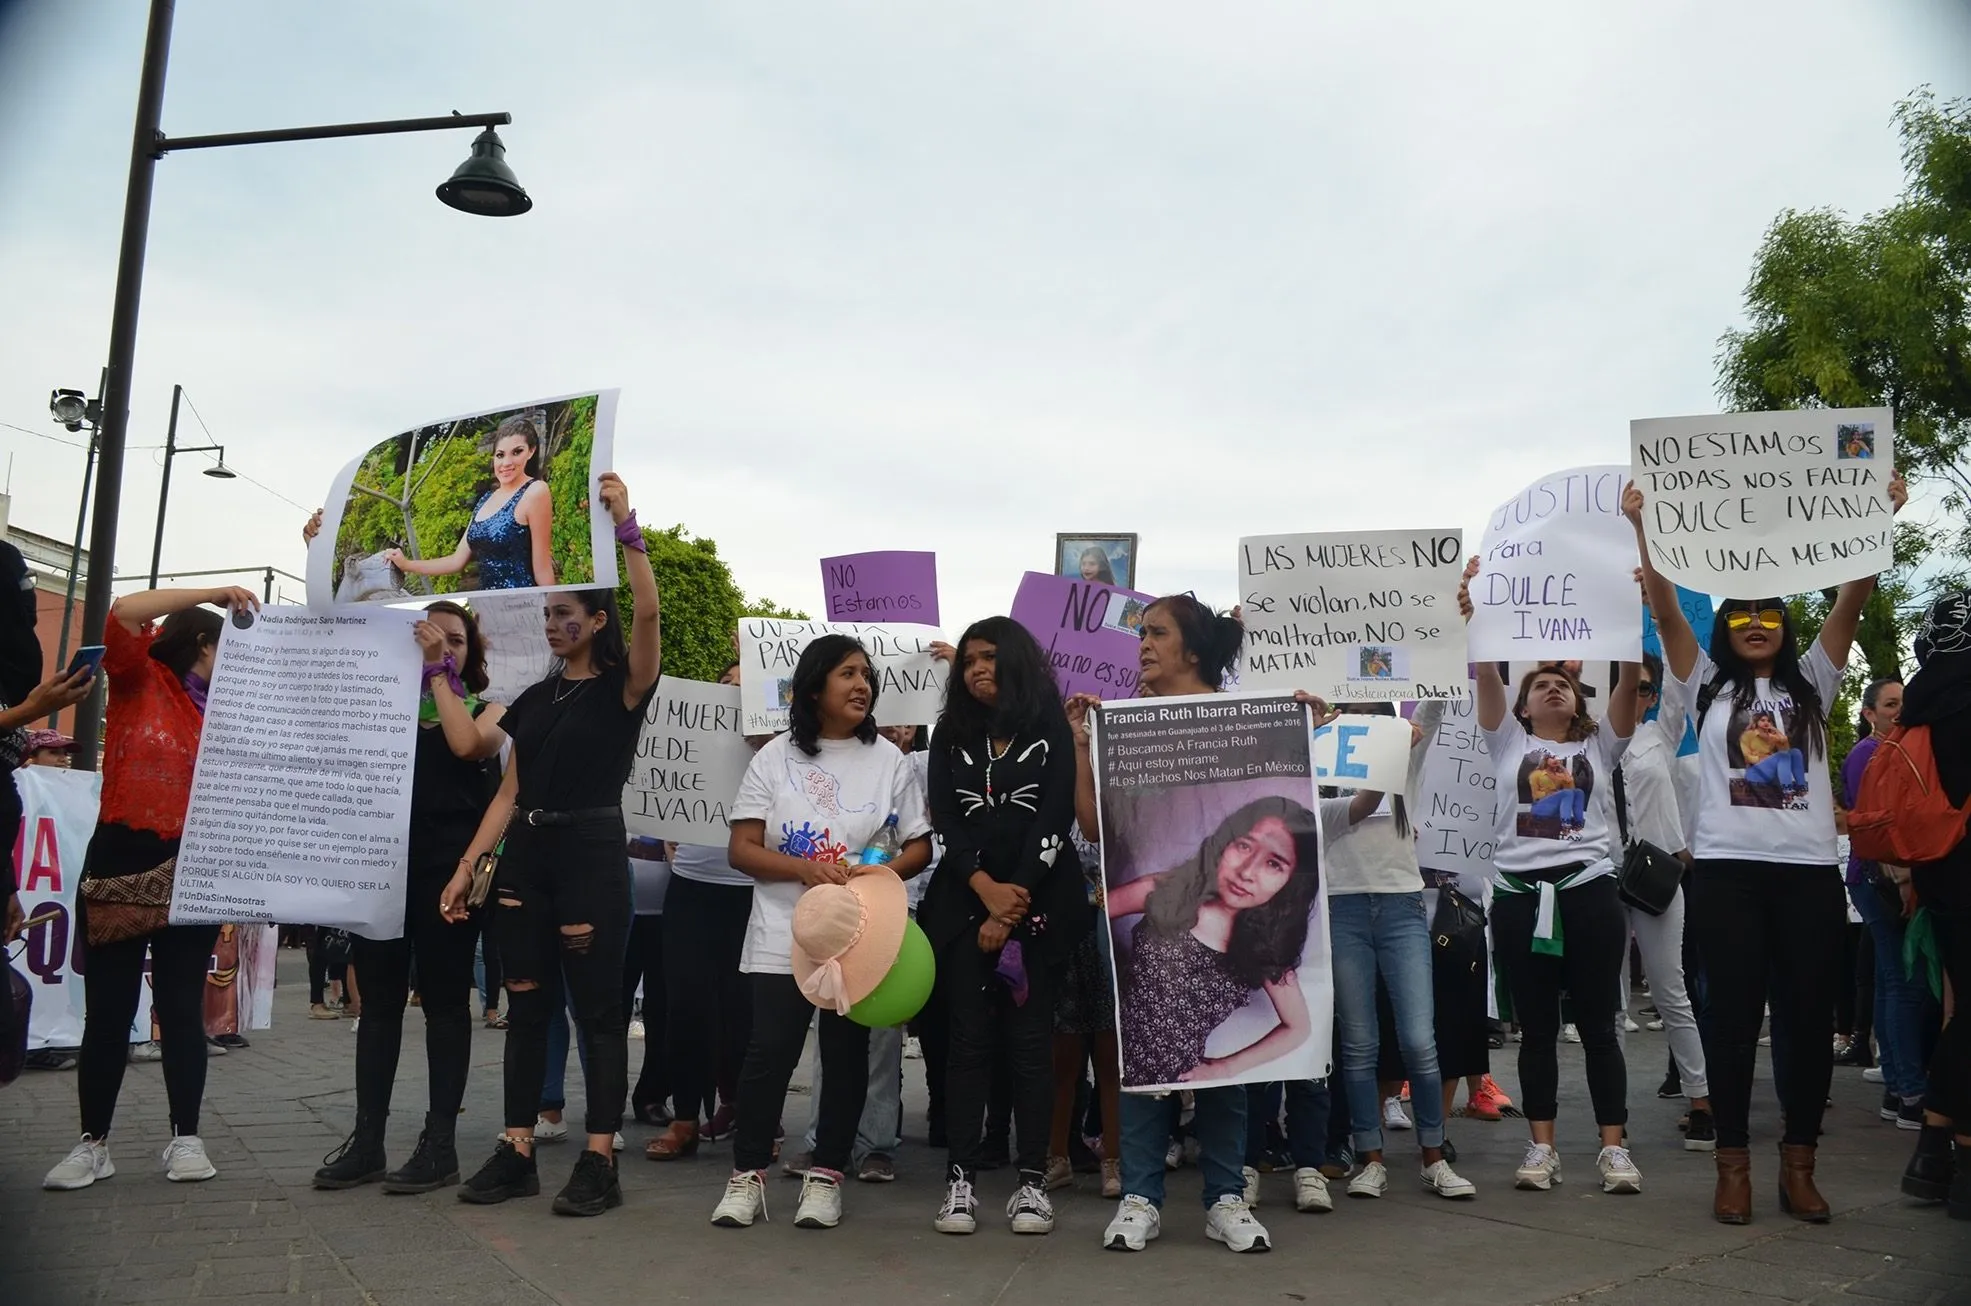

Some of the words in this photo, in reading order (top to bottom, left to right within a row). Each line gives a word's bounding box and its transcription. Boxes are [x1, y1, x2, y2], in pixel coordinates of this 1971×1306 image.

[1639, 436, 1681, 467] NO
[1688, 431, 1823, 460] ESTAMOS
[1643, 469, 1731, 492] TODAS
[1743, 470, 1793, 489] NOS
[1806, 466, 1877, 487] FALTA
[1494, 473, 1626, 531] JUSTICI
[1656, 497, 1757, 535] DULCE
[1787, 494, 1888, 522] IVANA
[1244, 543, 1296, 576] LAS
[1306, 543, 1406, 569] MUJERES
[1411, 536, 1460, 569] NO
[1652, 539, 1690, 571] NI
[1705, 546, 1780, 572] UNA
[830, 563, 856, 590] NO
[1369, 589, 1403, 609] NO
[1409, 593, 1436, 608] se
[1482, 572, 1577, 607] DULCE
[832, 591, 923, 615] Estamos
[1060, 582, 1110, 634] NO
[259, 613, 283, 624] Nadia
[318, 616, 334, 625] Saro
[1512, 610, 1592, 641] IVANA
[1365, 620, 1405, 644] NO
[1414, 625, 1441, 641] se
[220, 663, 277, 678] recuérdenme
[277, 670, 298, 679] como
[298, 671, 307, 681] yo
[313, 671, 340, 681] ustedes
[341, 672, 353, 681] los
[1071, 654, 1092, 674] no
[1094, 661, 1115, 683] es
[1249, 650, 1317, 674] MATAN
[210, 710, 237, 720] menos
[239, 712, 265, 724] hagan
[266, 717, 286, 725] caso
[294, 719, 340, 729] comentarios
[341, 722, 387, 733] machistas
[389, 726, 407, 735] que
[212, 698, 243, 709] medios
[244, 701, 256, 710] de
[257, 704, 310, 715] comunicación
[311, 708, 341, 717] creando
[342, 710, 371, 719] morbo
[372, 712, 378, 721] y
[379, 712, 411, 722] mucho
[1104, 709, 1155, 725] Francia
[1159, 707, 1193, 721] Ruth
[1196, 705, 1237, 719] Ibarra
[1240, 700, 1299, 716] Ramirez
[1107, 731, 1119, 741] fue
[1120, 729, 1157, 739] asesinada
[1157, 729, 1168, 737] en
[1168, 725, 1209, 737] Guanajuato
[1210, 724, 1218, 732] el
[1219, 724, 1224, 732] 3
[1225, 723, 1234, 732] de
[1236, 719, 1273, 731] Diciembre
[1273, 719, 1283, 728] de
[1117, 743, 1175, 757] Buscamos
[1176, 740, 1185, 751] A
[1187, 736, 1228, 751] Francia
[1231, 735, 1258, 748] Ruth
[1109, 775, 1136, 788] #Los
[1138, 770, 1182, 785] Machos
[1184, 769, 1206, 782] Nos
[1209, 766, 1244, 779] Matan
[1246, 763, 1262, 775] En
[1265, 760, 1305, 773] México
[1145, 757, 1175, 771] estoy
[1178, 753, 1219, 767] mirame
[191, 806, 211, 815] pero
[211, 807, 243, 818] termino
[244, 811, 297, 823] quitándome
[298, 815, 306, 824] la
[308, 816, 329, 826] vida.
[194, 793, 234, 805] realmente
[235, 798, 272, 809] pensaba
[274, 802, 290, 811] que
[291, 802, 300, 811] el
[301, 804, 331, 814] mundo
[332, 806, 357, 817] podía
[358, 809, 395, 820] cambiar
[1431, 791, 1480, 822] Nos
[187, 829, 198, 838] mi
[200, 831, 231, 842] sobrina
[232, 834, 263, 845] porque
[264, 838, 275, 847] yo
[277, 838, 301, 849] quise
[303, 841, 317, 849] ser
[318, 843, 330, 851] un
[331, 844, 367, 855] ejemplo
[368, 847, 389, 857] para
[190, 854, 217, 865] luchar
[218, 858, 234, 868] por
[235, 859, 247, 868] su
[248, 861, 270, 870] vida.
[181, 865, 220, 878] PORQUE
[221, 869, 230, 879] SI
[266, 872, 282, 883] DÍA
[283, 874, 303, 885] SOY
[321, 878, 356, 889] QUIERO
[357, 880, 377, 890] SER
[378, 882, 391, 891] LA
[176, 902, 273, 919] #9deMarzoIberoLeon
[178, 890, 266, 907] #UnDiaSinNosotras
